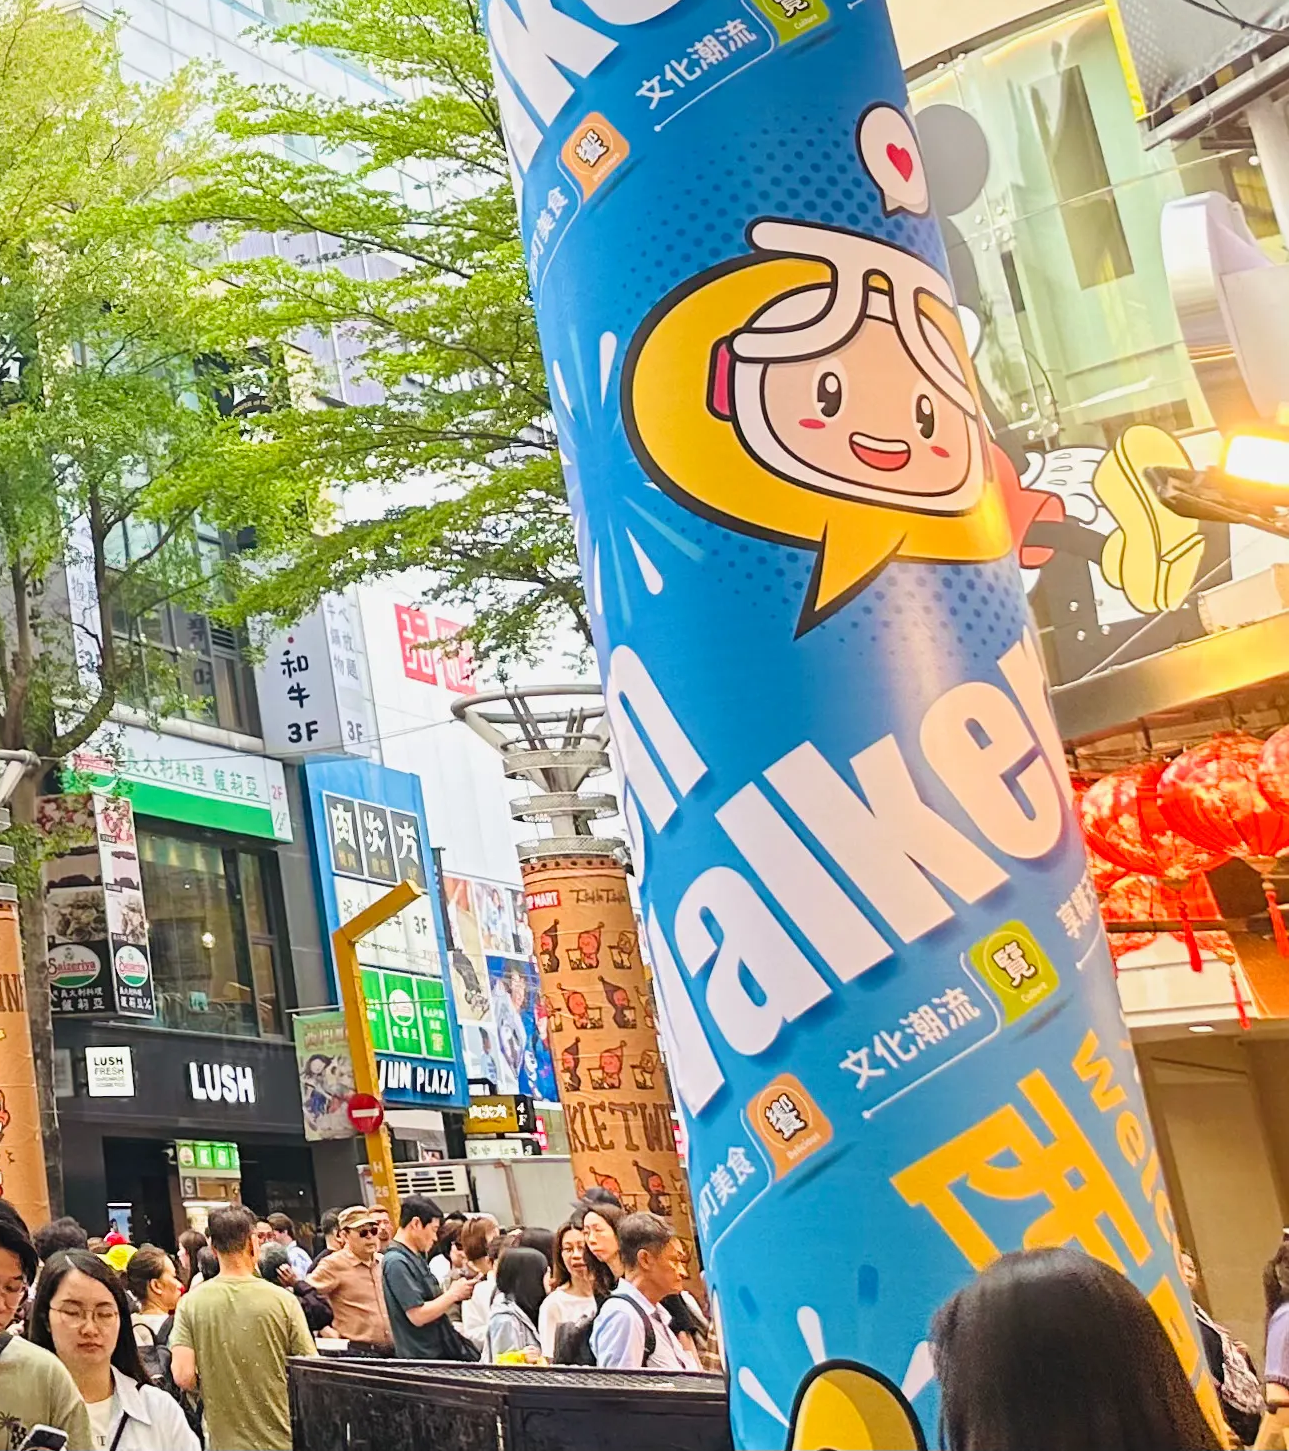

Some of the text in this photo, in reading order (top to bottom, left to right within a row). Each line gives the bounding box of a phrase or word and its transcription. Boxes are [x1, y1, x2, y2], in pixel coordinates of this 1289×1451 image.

[635, 16, 758, 110] 文化潮流
[287, 721, 320, 745] 3F
[534, 891, 559, 907] MART
[48, 957, 97, 976] Saizeriya
[994, 941, 1038, 989] 覽
[838, 986, 981, 1090] 文化潮流
[93, 1056, 124, 1066] LUSH
[189, 1061, 256, 1104] LUSH
[416, 1066, 456, 1095] PLAZA
[763, 1092, 807, 1142] 饗
[785, 1131, 823, 1162] Delicious
[1071, 1029, 1185, 1285] welc
